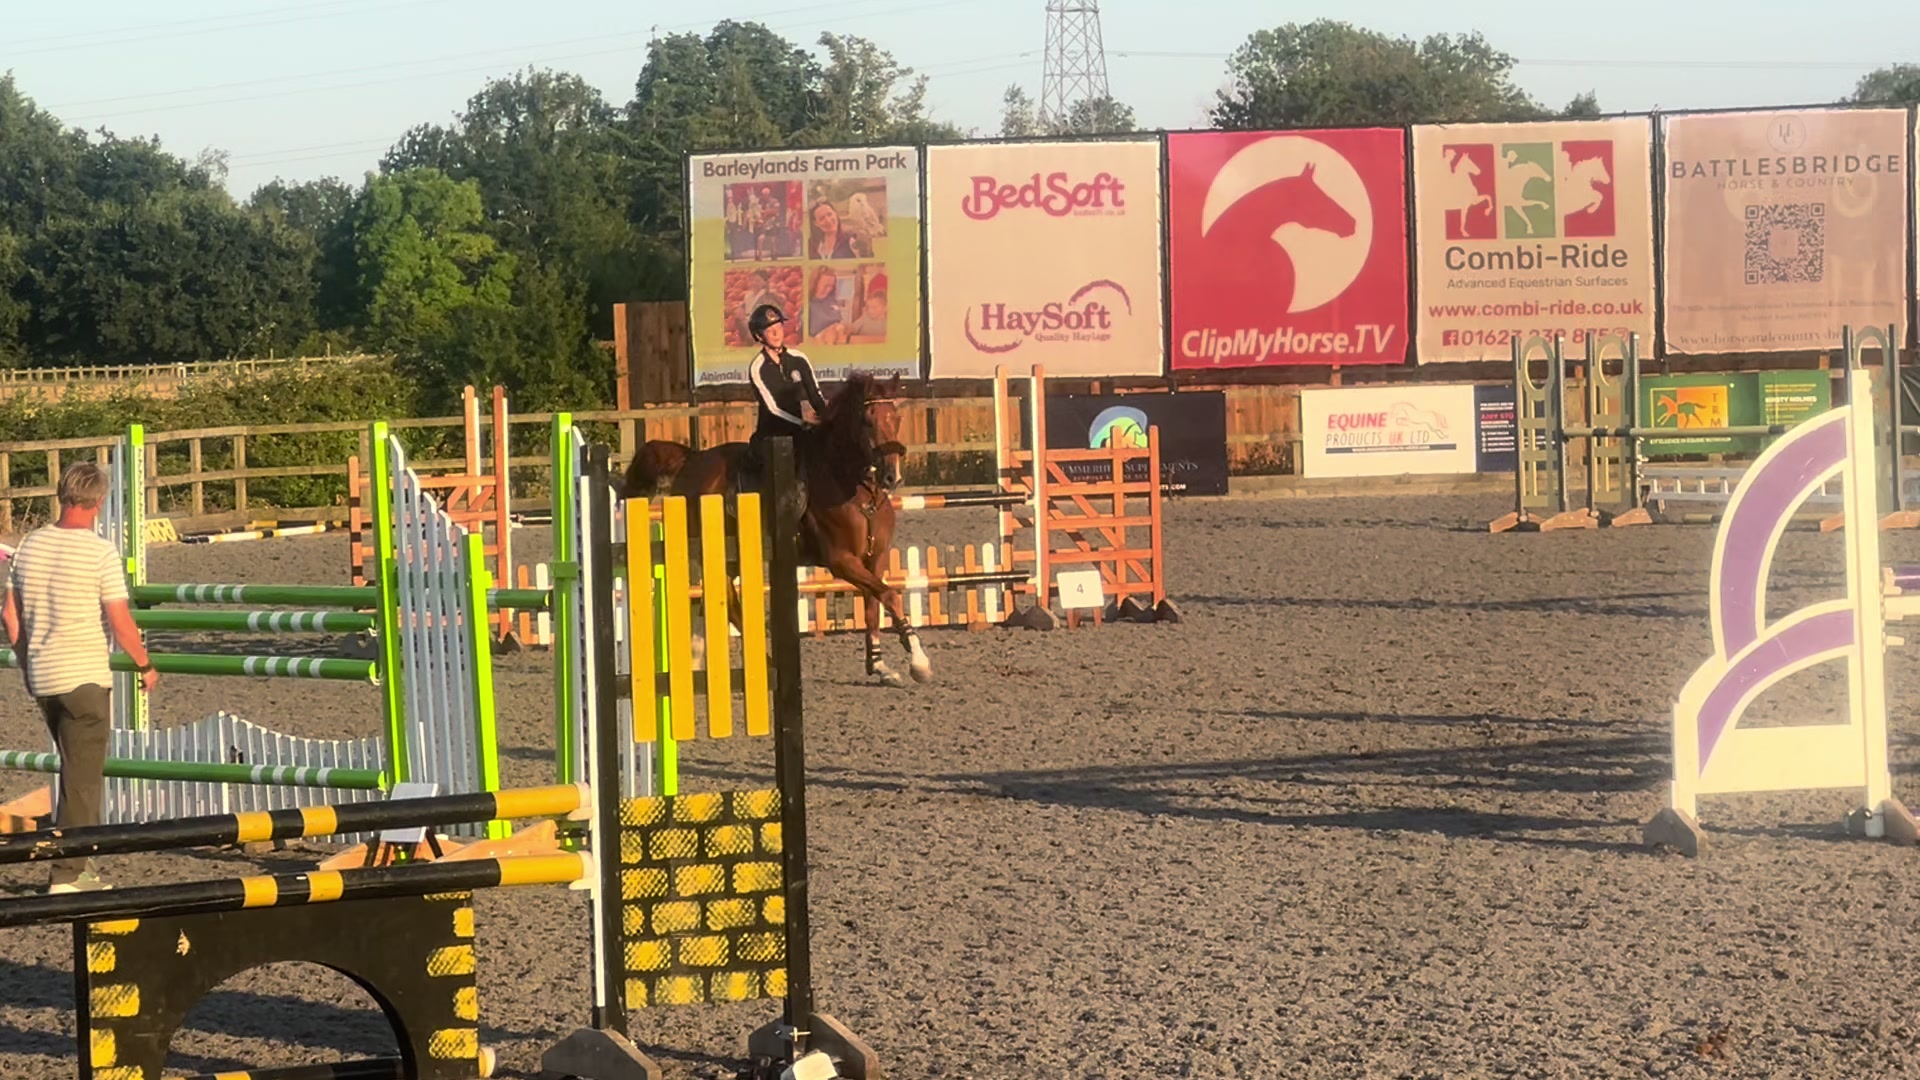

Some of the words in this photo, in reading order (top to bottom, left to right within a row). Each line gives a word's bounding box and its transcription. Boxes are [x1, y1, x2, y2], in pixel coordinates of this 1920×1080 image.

[703, 156, 809, 179] Barleylands
[814, 155, 860, 172] Farm
[866, 152, 907, 170] Park
[1671, 154, 1900, 179] BATTLESBRIDGE
[1717, 178, 1764, 190] HORSE
[1771, 177, 1780, 189] &
[1786, 176, 1854, 189] COUNTRY
[962, 171, 1125, 221] BedSoft
[1445, 243, 1628, 271] Combi-Ride
[1447, 277, 1506, 289] Advanced
[1509, 276, 1572, 289] Equestrian
[1576, 275, 1628, 287] Surfaces
[1429, 299, 1643, 318] www.combi-ride.co.uk
[981, 302, 1112, 336] HaySoft
[1035, 333, 1069, 342] Quality
[1072, 332, 1111, 342] Haylage
[1181, 324, 1396, 364] ClipMyHorse.TV
[700, 370, 742, 382] Animals
[1327, 412, 1388, 431] EQUINE
[1326, 431, 1383, 446] PRODUCTS
[1388, 431, 1403, 445] UK
[1410, 430, 1430, 444] LTD
[1076, 583, 1084, 594] 4
